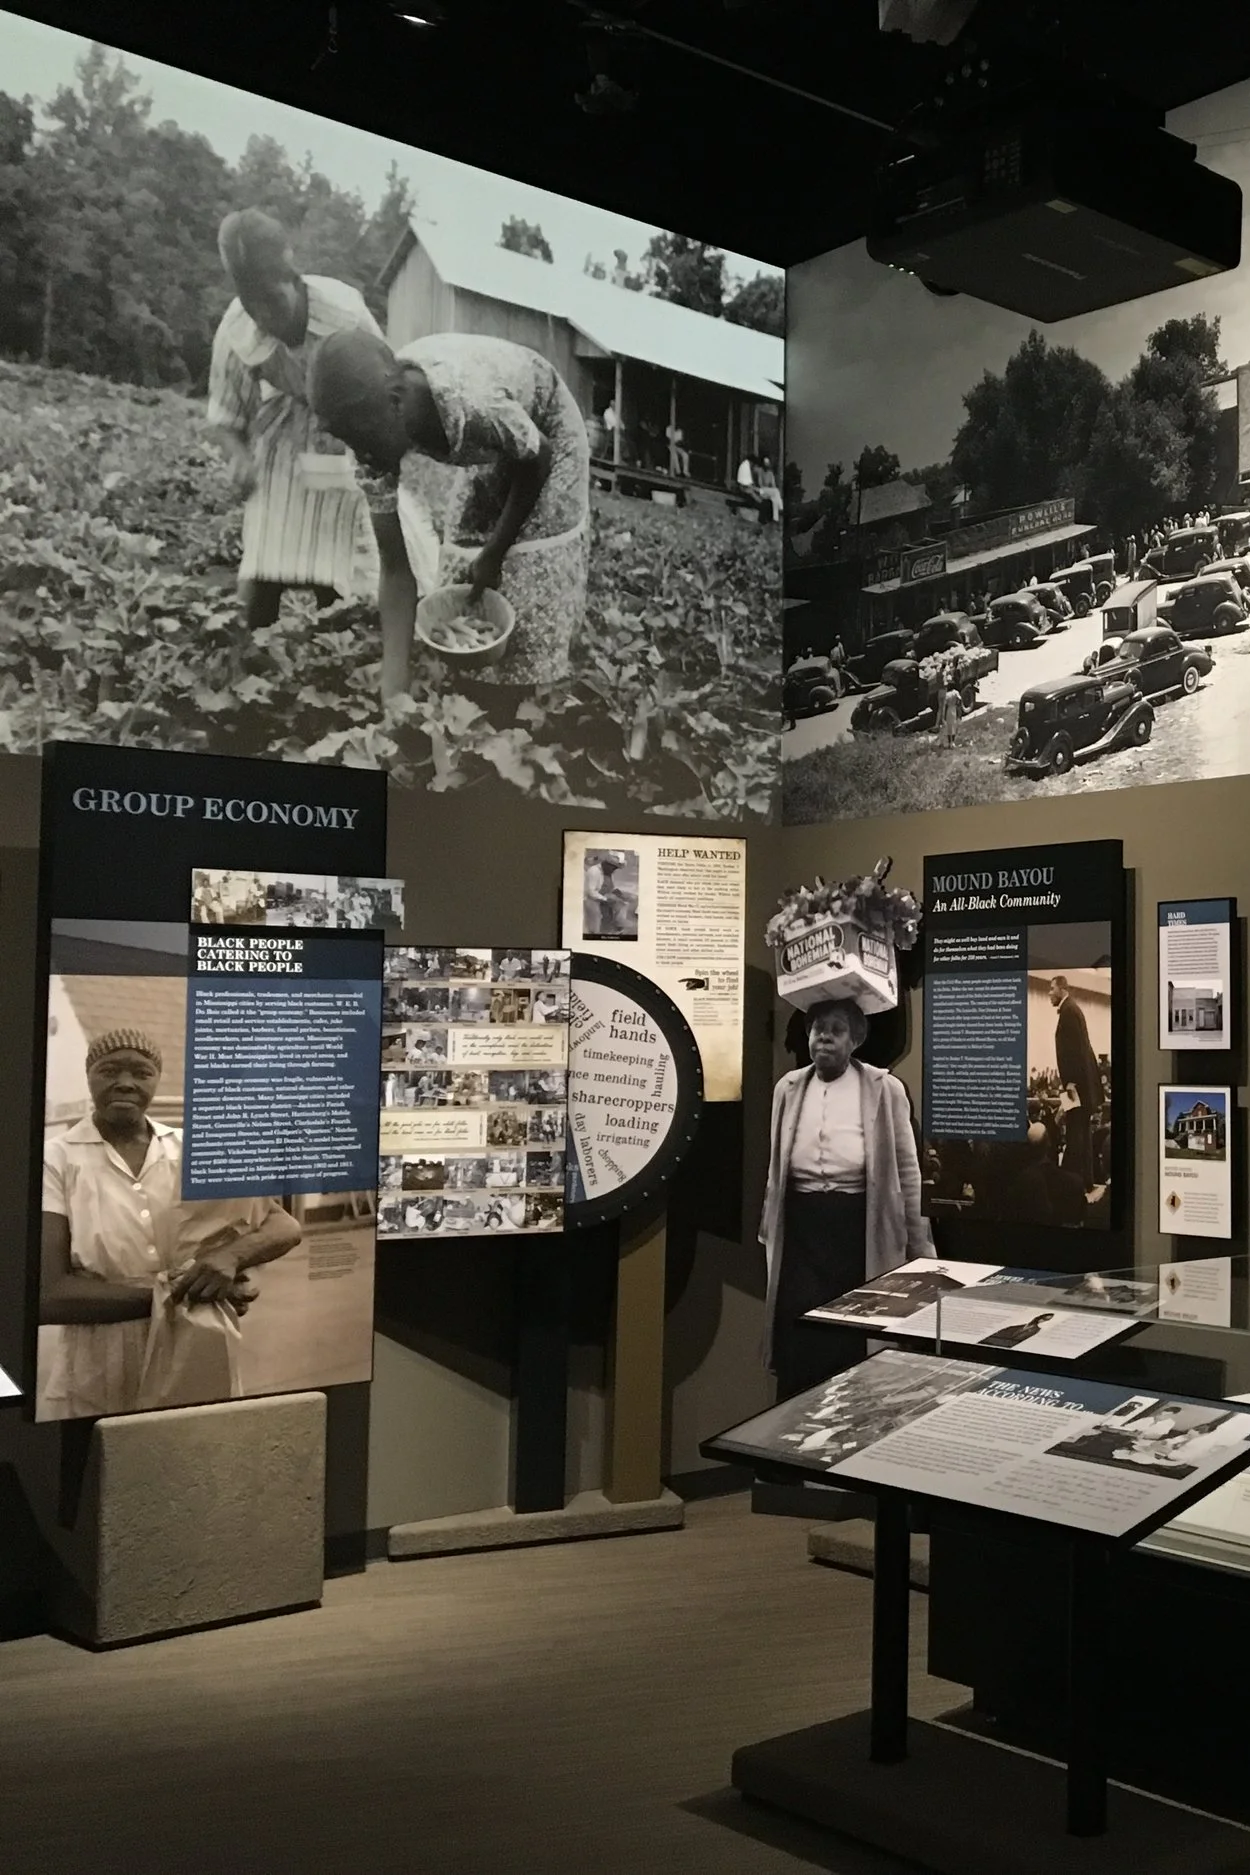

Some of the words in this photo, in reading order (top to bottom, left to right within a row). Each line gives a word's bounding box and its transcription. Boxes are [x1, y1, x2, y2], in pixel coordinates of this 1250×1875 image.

[72, 788, 195, 818] GROUP
[202, 797, 359, 830] ECONOMY
[657, 848, 689, 858] HELP
[692, 849, 741, 860] WANTED
[932, 873, 993, 893] MOUND
[998, 867, 1055, 888] BAYOU
[933, 899, 947, 913] An
[949, 895, 996, 912] All-Black
[1000, 891, 1061, 909] Community
[1167, 911, 1186, 920] HARD
[197, 937, 245, 949] BLACK
[249, 938, 304, 951] PEOPLE
[786, 927, 835, 961] NATIONAL
[197, 948, 269, 961] CATERING
[273, 949, 293, 961] TO
[196, 960, 245, 973] BLACK
[249, 961, 304, 974] PEOPLE
[611, 1010, 647, 1027] field
[608, 1025, 657, 1044] hands
[583, 1048, 654, 1069] timekeeping
[593, 1073, 647, 1090] mending
[651, 1053, 670, 1098] hauling
[571, 1090, 674, 1114] sharecroppers
[574, 1112, 587, 1134] day
[605, 1114, 660, 1134] loading
[596, 1132, 651, 1149] irrigating
[580, 1137, 599, 1187] laborers
[598, 1148, 628, 1184] chopping
[976, 1387, 1061, 1408] ACCORDING
[988, 1380, 1021, 1391] THE
[1018, 1386, 1065, 1399] NEWS
